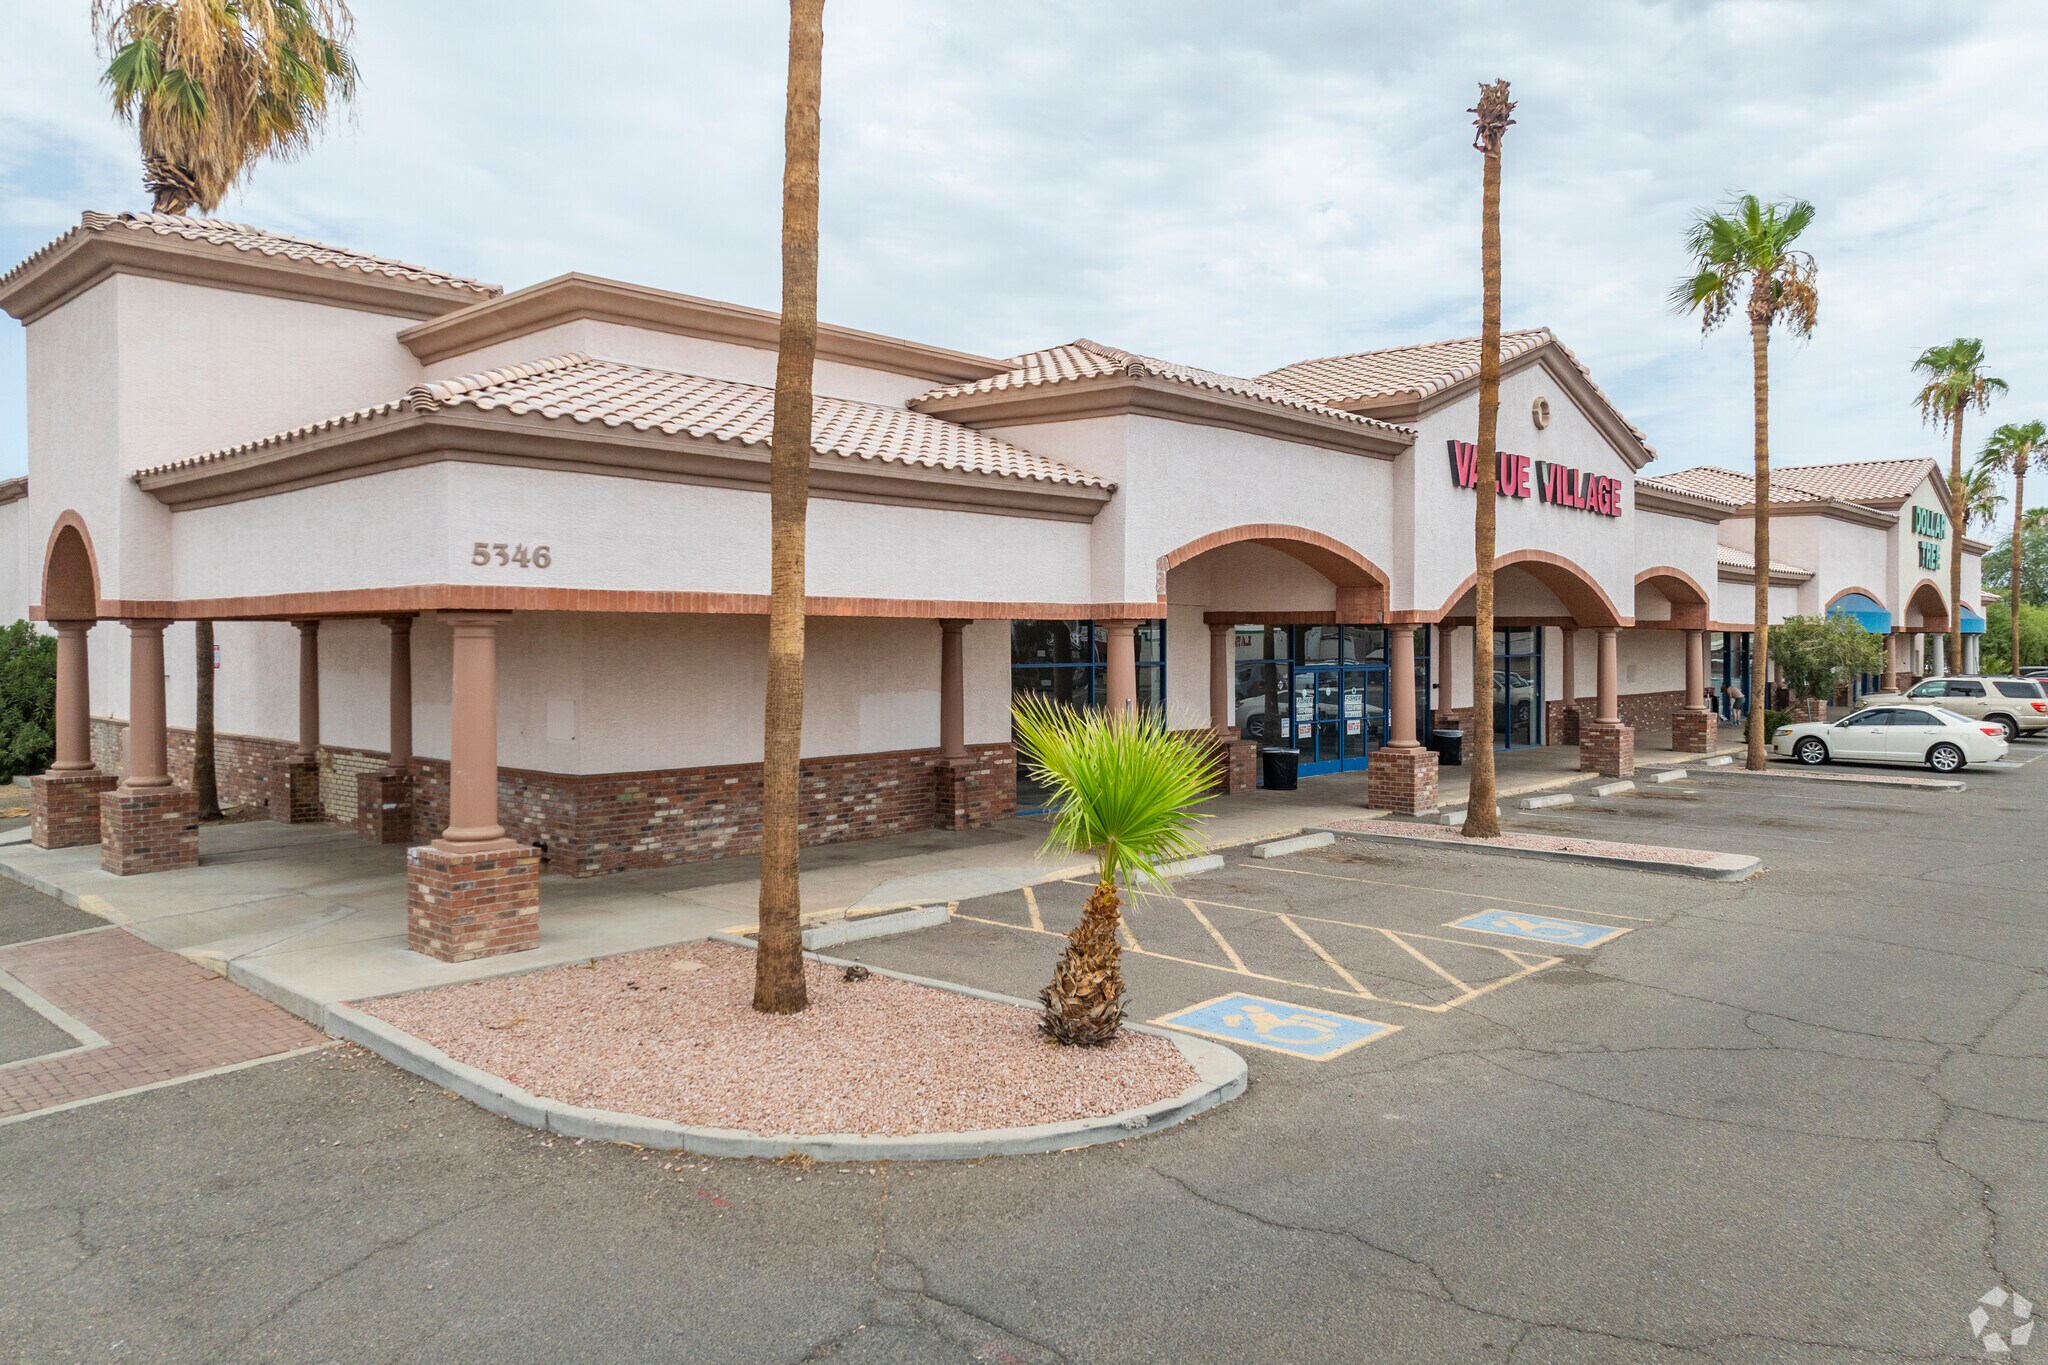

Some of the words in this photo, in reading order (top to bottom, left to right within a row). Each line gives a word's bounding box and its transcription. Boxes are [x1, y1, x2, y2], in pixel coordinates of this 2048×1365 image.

[1535, 461, 1622, 517] VILLAGE
[1912, 506, 1946, 539] DOLLAR
[471, 542, 552, 569] 5346
[1918, 541, 1941, 570] TREE
